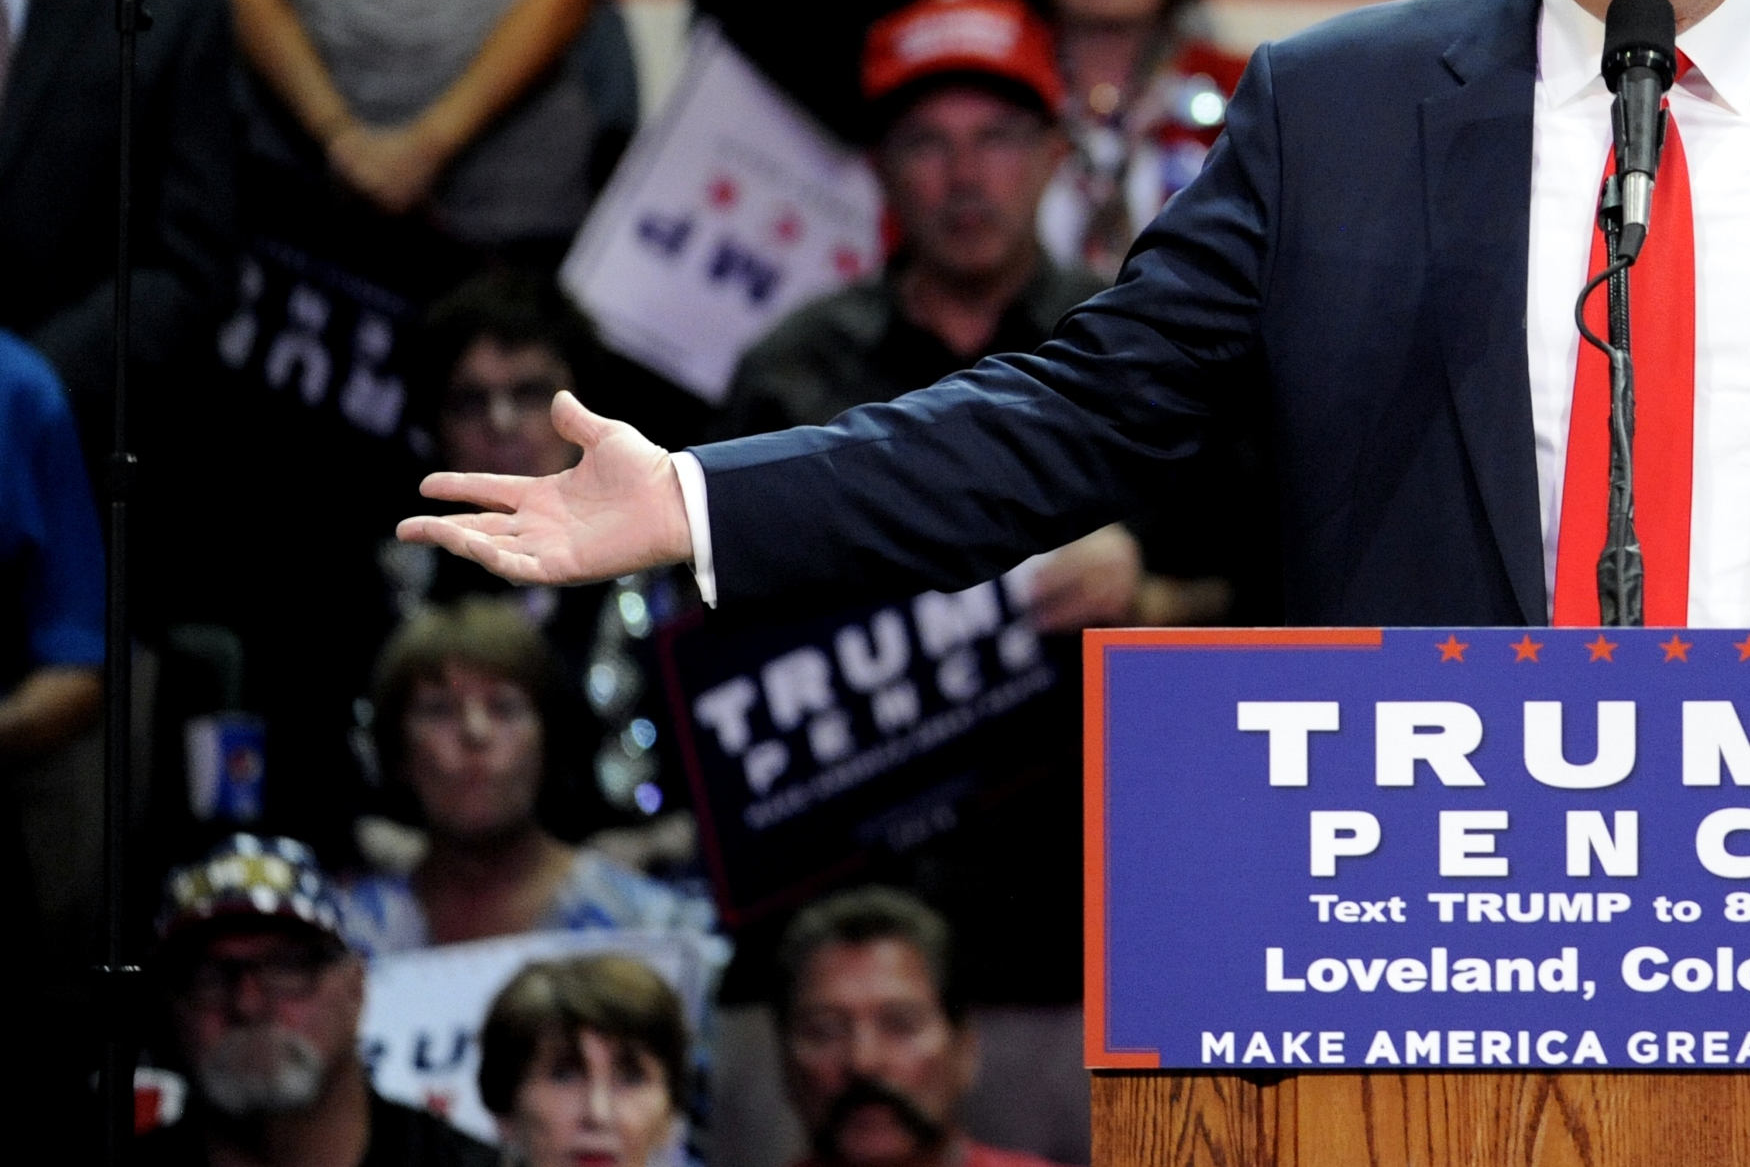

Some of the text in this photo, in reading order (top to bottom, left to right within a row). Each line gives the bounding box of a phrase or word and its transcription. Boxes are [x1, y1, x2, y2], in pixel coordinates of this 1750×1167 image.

[1309, 891, 1405, 923] Text
[1426, 891, 1631, 923] TRUMP
[1653, 893, 1702, 923] to
[1265, 945, 1596, 1000] Loveland,
[1200, 1029, 1345, 1065] MAKE
[1363, 1029, 1608, 1065] AMERICA
